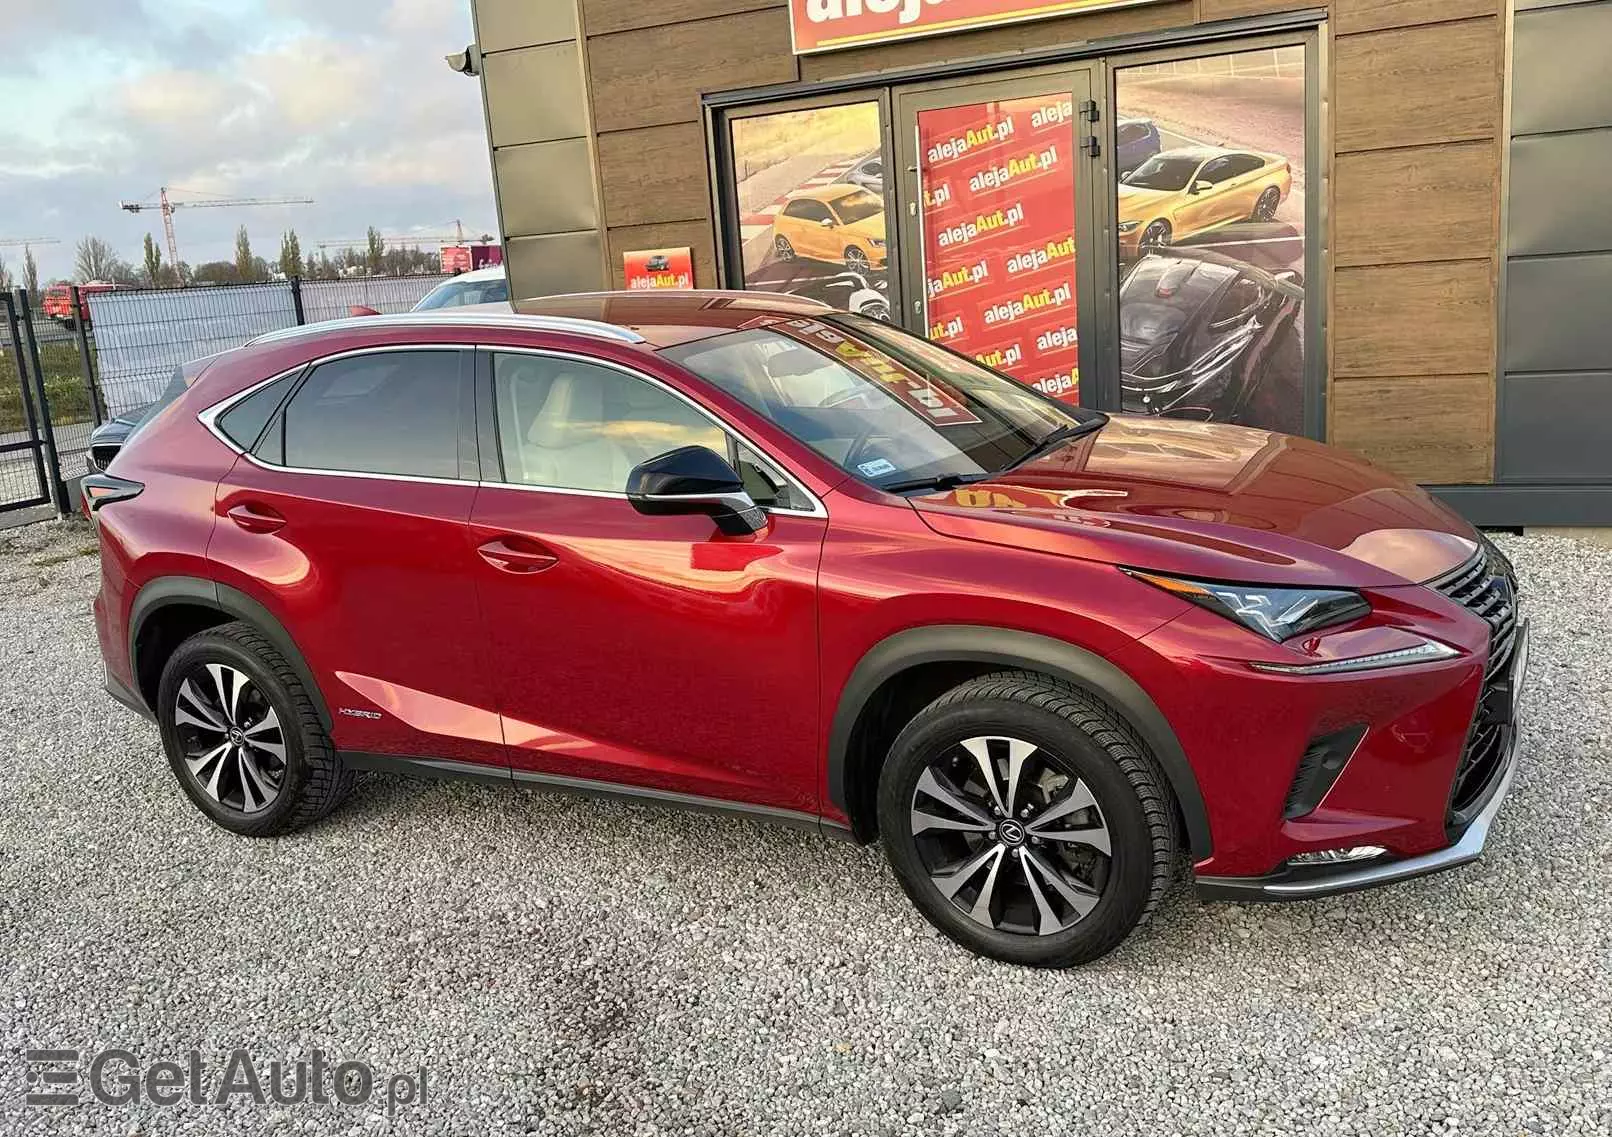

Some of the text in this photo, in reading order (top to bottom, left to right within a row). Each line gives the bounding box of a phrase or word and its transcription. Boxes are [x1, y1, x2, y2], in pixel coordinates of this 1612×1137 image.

[1031, 101, 1072, 128] aleja
[927, 116, 1015, 163] alejaAut.pl
[968, 145, 1058, 192] alejaAut.pl
[924, 184, 951, 208] t.pl
[938, 203, 1024, 247] alejaAut.pl
[630, 272, 689, 289] alejaAut.pl
[983, 283, 1072, 325] alejaAut.pl
[1036, 327, 1078, 350] aleja
[338, 708, 382, 719] HYBRID
